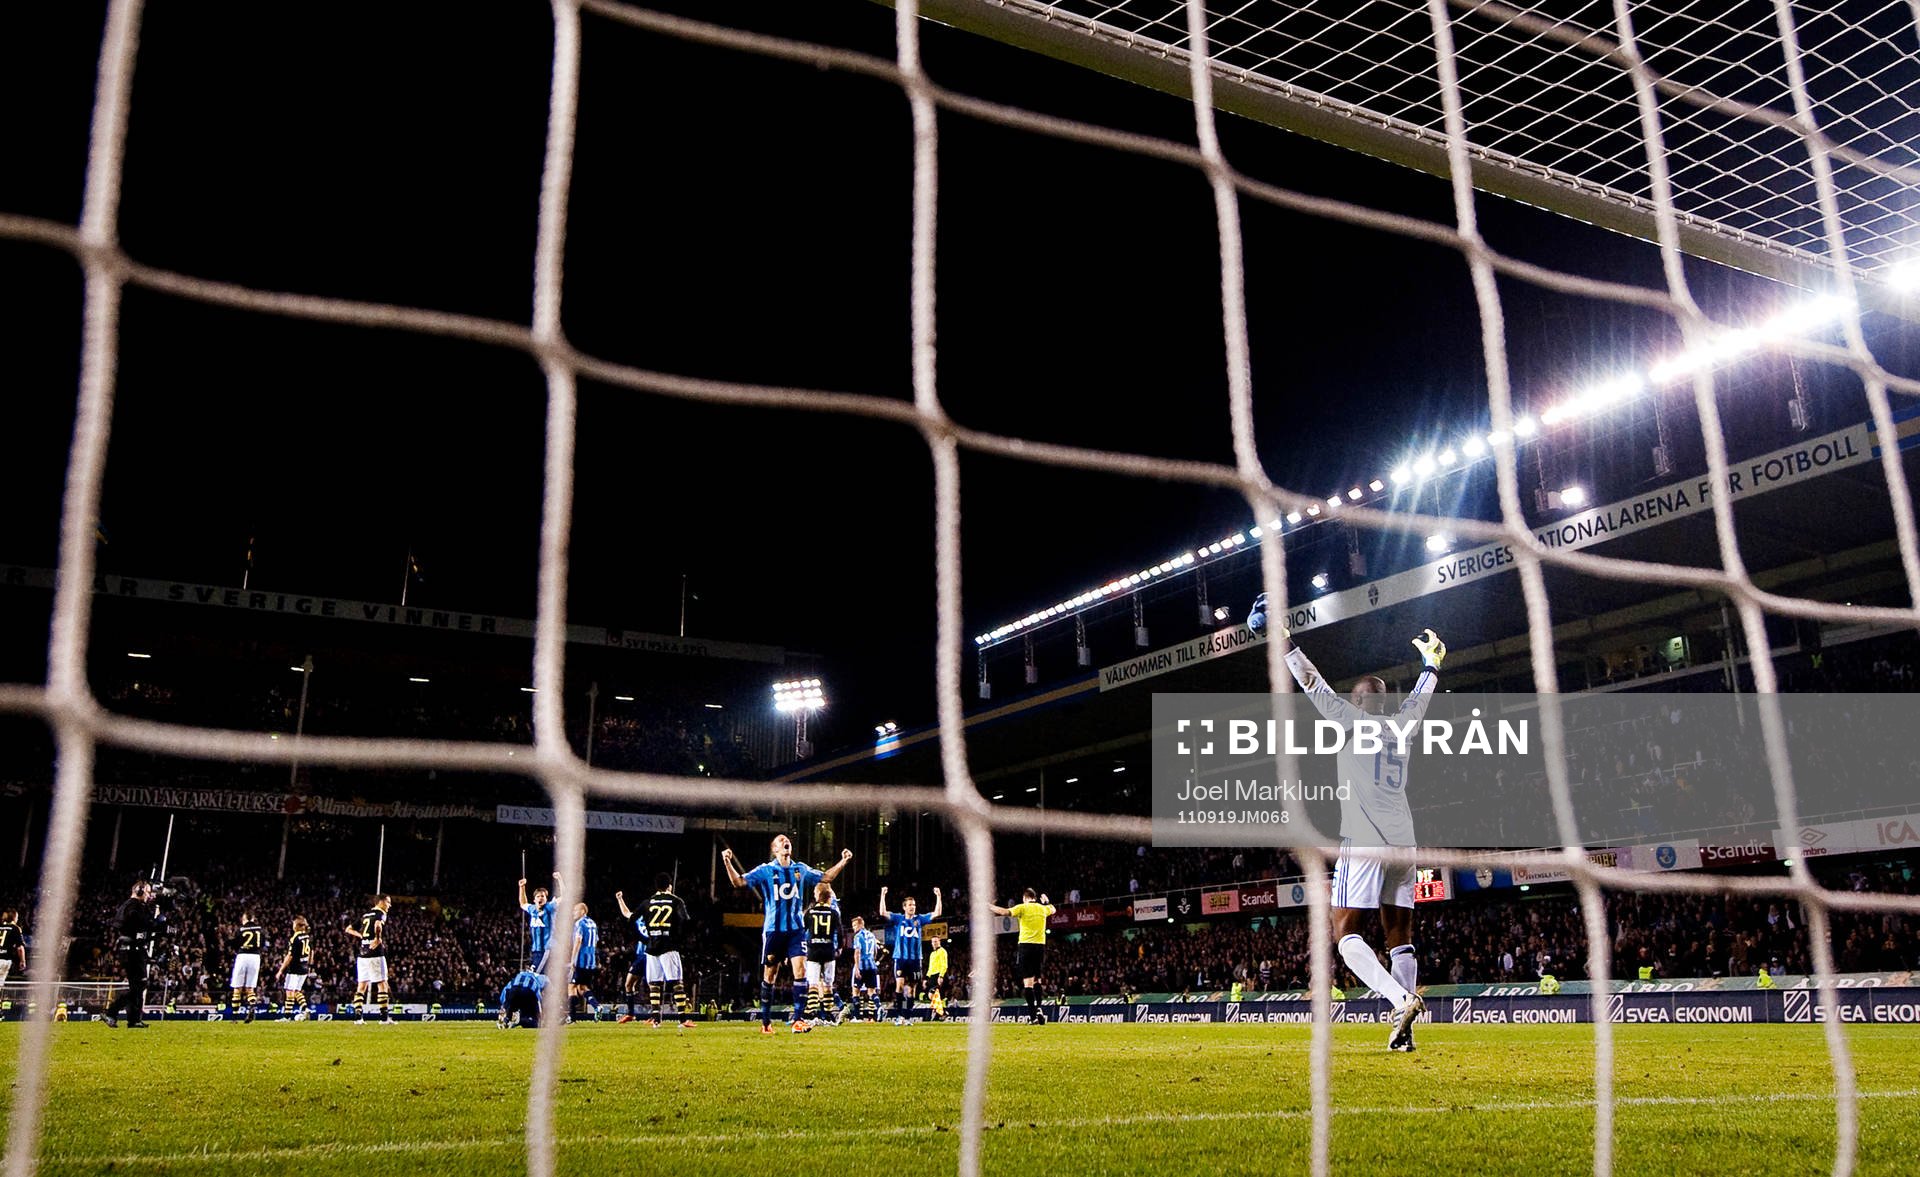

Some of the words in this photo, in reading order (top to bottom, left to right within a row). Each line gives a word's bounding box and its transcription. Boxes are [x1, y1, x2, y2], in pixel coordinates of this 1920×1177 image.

[1437, 545, 1514, 584] SVERIGES
[1537, 489, 1689, 549] ATIONALARENA
[1698, 472, 1743, 503] FR
[1752, 436, 1859, 486] FOTBOLL
[168, 583, 337, 616] SVERIGE
[362, 604, 497, 633] VINNER
[1105, 652, 1172, 686] VÄLKOMMEN
[1176, 645, 1196, 665] TILL
[1199, 629, 1256, 660] RÅSUNDA
[1374, 742, 1404, 789] 15
[500, 807, 532, 820] DEN
[541, 810, 602, 824] STA
[611, 815, 676, 830] MASSAN
[1877, 818, 1920, 846] ICA
[1706, 838, 1769, 861] Scandic
[1801, 846, 1827, 857] mbro
[773, 882, 801, 901] ICA
[1241, 891, 1275, 907] Scandic
[649, 905, 673, 928] 22
[812, 914, 832, 936] 14
[242, 931, 261, 948] 21
[900, 926, 919, 939] ICA
[1069, 1014, 1087, 1023] SVEA
[1089, 1013, 1124, 1023] EKONOMI
[1148, 1013, 1169, 1023] SVEA
[1240, 1013, 1264, 1023] SVEA
[1267, 1012, 1312, 1023] EKONOMI
[1346, 1012, 1375, 1023] SVEA
[1472, 1010, 1508, 1023] SVEA
[1512, 1009, 1576, 1023] EKONOMI
[1626, 1008, 1669, 1023] SVEA
[1675, 1006, 1752, 1023] EKONOMI
